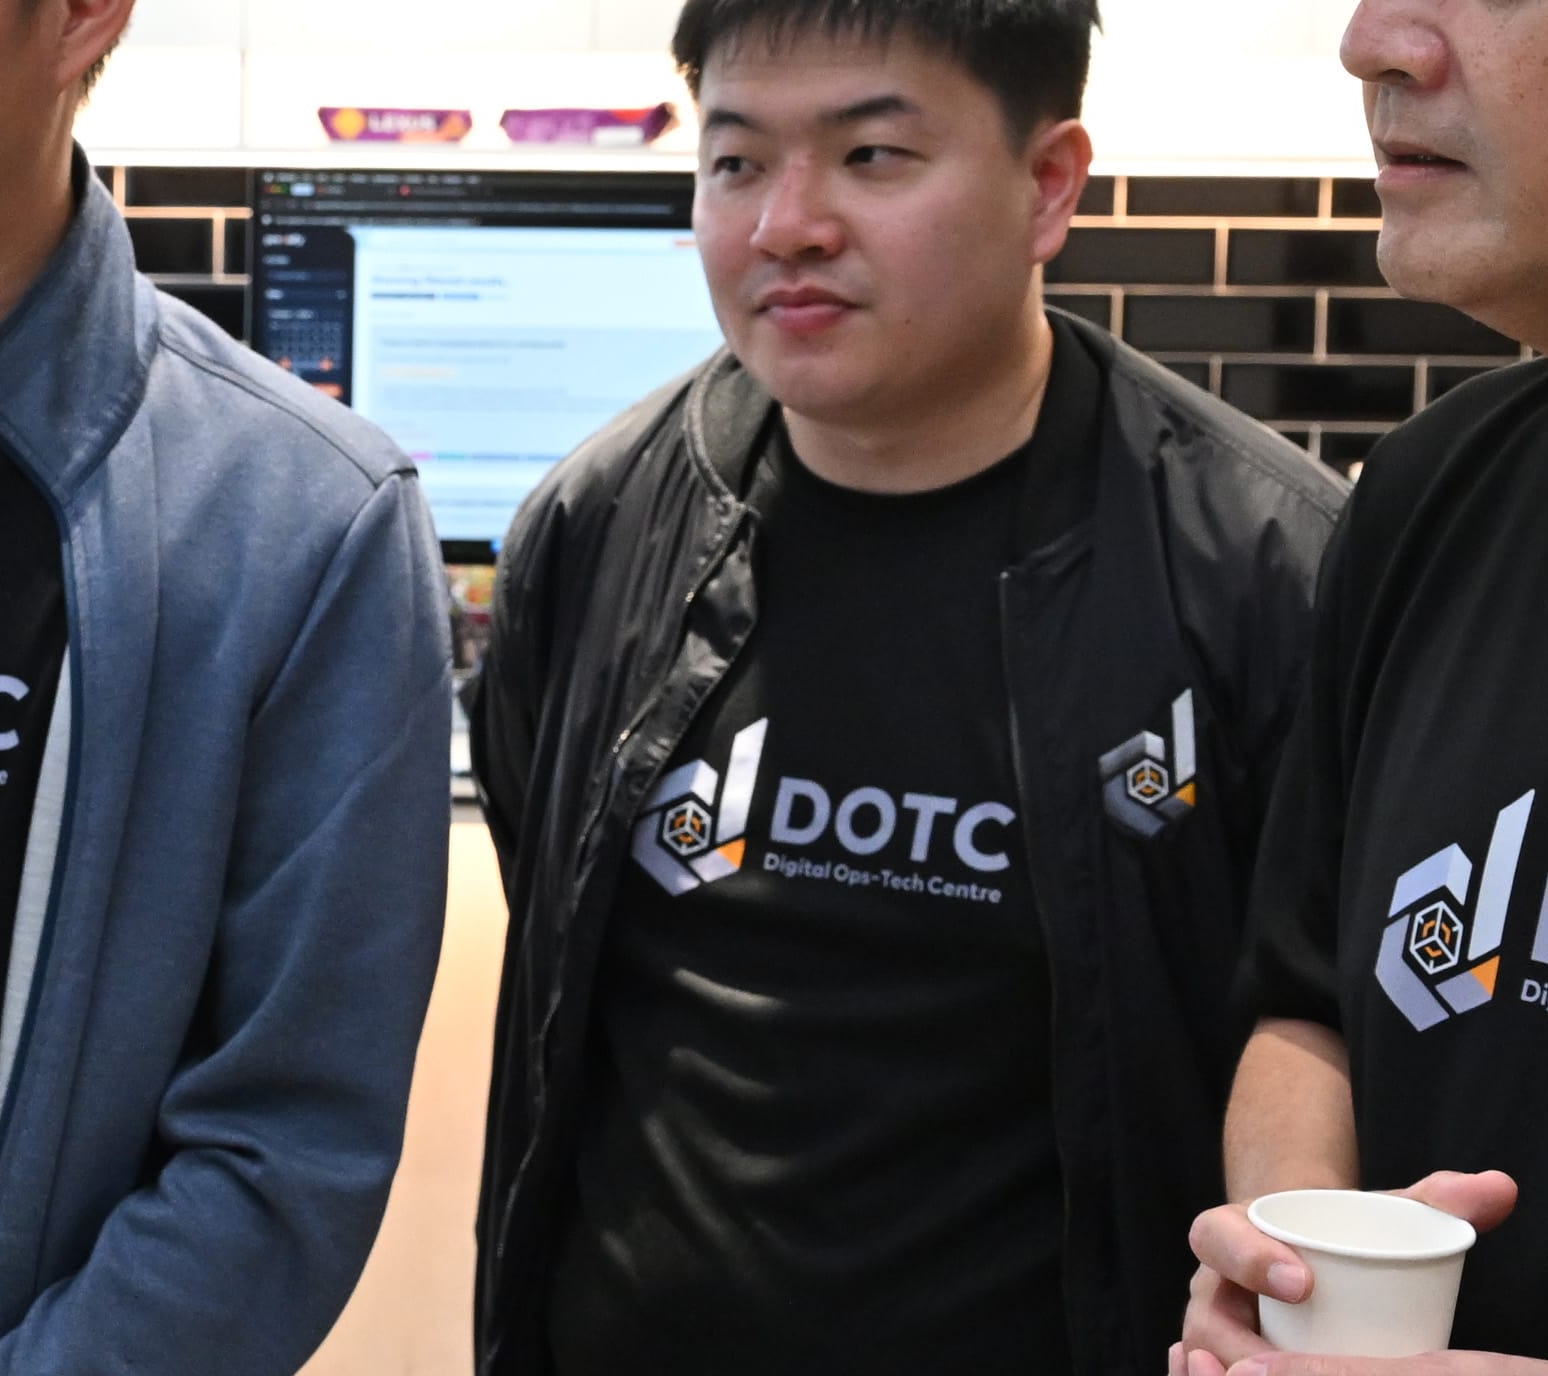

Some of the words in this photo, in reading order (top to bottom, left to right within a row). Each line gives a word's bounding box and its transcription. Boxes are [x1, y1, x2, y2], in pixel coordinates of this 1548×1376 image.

[770, 776, 1018, 873] DOTC
[765, 852, 831, 882] Digital
[833, 862, 925, 894] Ops-Tech
[928, 874, 1003, 905] Centre
